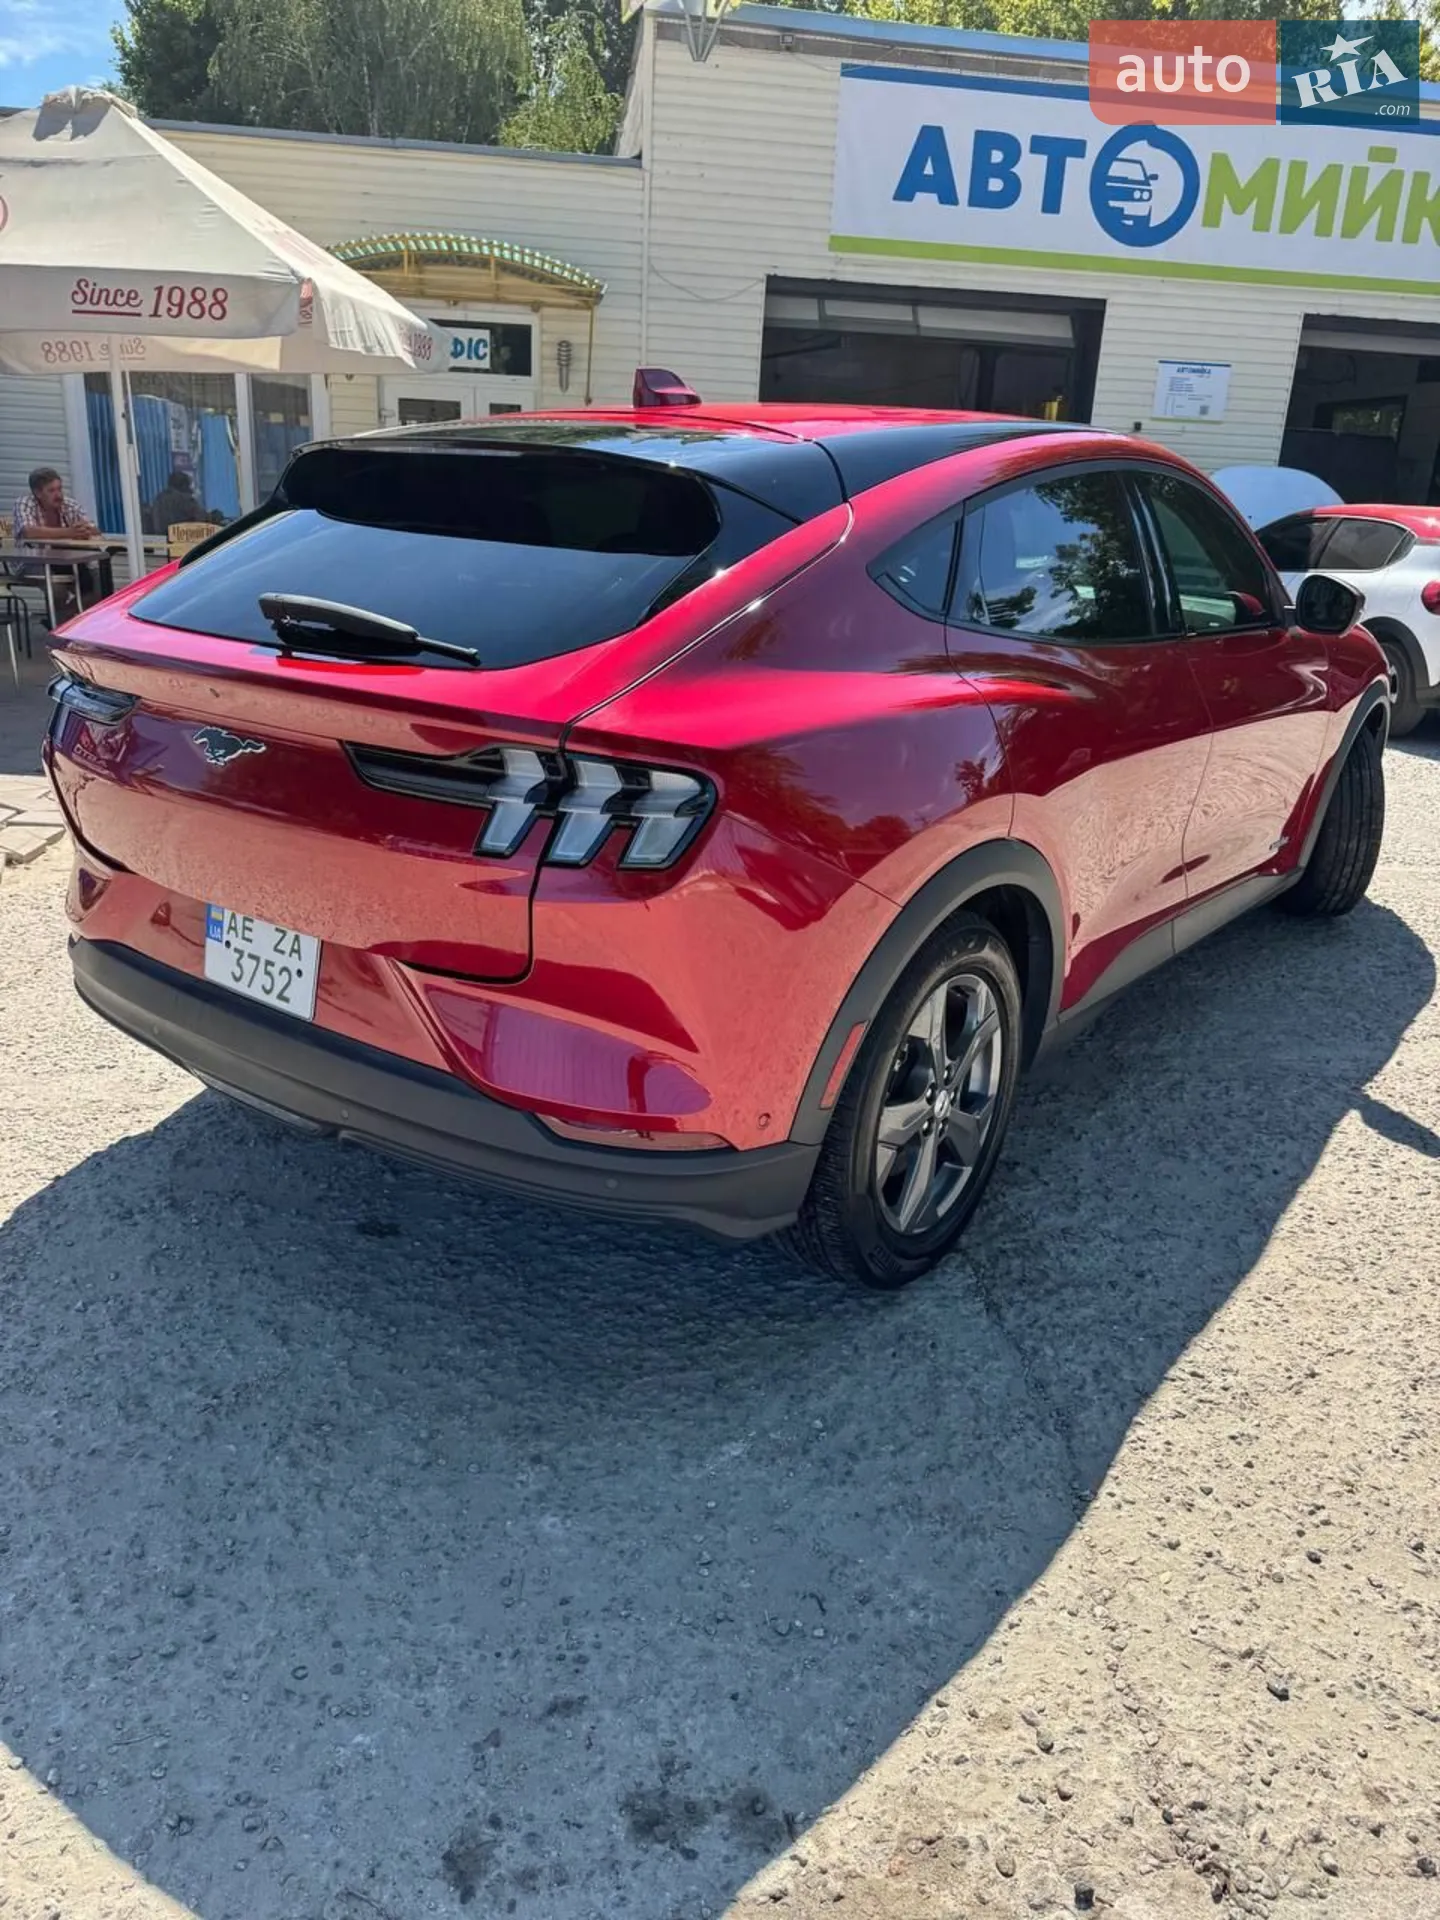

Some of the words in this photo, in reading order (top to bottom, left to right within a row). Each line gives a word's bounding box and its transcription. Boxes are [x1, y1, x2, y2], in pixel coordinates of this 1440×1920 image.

[71, 278, 143, 309] Since
[148, 285, 229, 321] 1988
[226, 911, 254, 944] AE
[273, 926, 302, 961] ZA
[231, 947, 293, 1004] 3752
